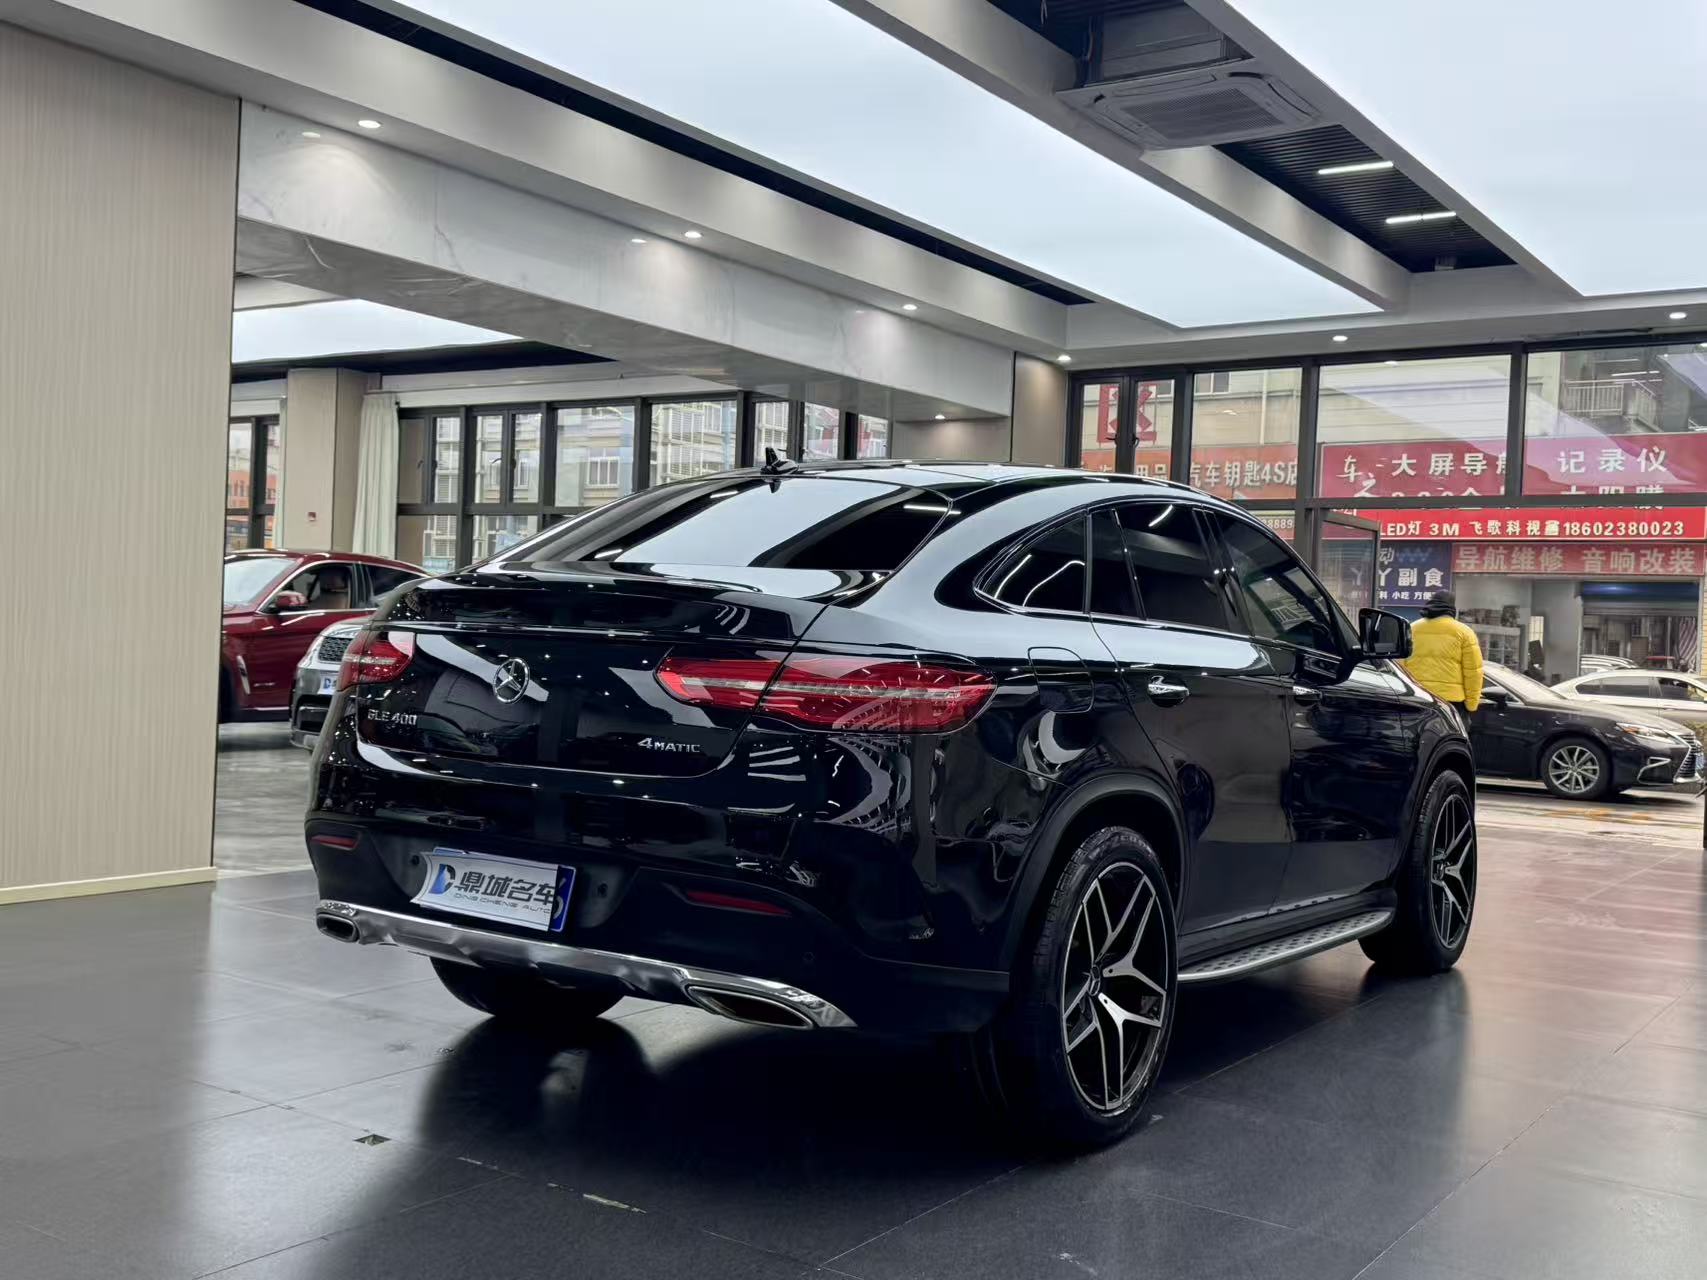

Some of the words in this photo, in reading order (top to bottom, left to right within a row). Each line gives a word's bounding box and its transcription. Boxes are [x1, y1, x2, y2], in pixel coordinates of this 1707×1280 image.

[1557, 446, 1667, 473] 记录仪
[1379, 520, 1422, 536] LED灯
[1429, 523, 1460, 536] 3M
[1563, 521, 1684, 536] 18602380023
[1455, 546, 1565, 571] 导航维修
[1583, 546, 1696, 574] 音响改装
[367, 708, 390, 722] GLE
[391, 712, 418, 726] 400
[636, 737, 701, 753] 4MATIC
[454, 871, 555, 906] 鼎城名车
